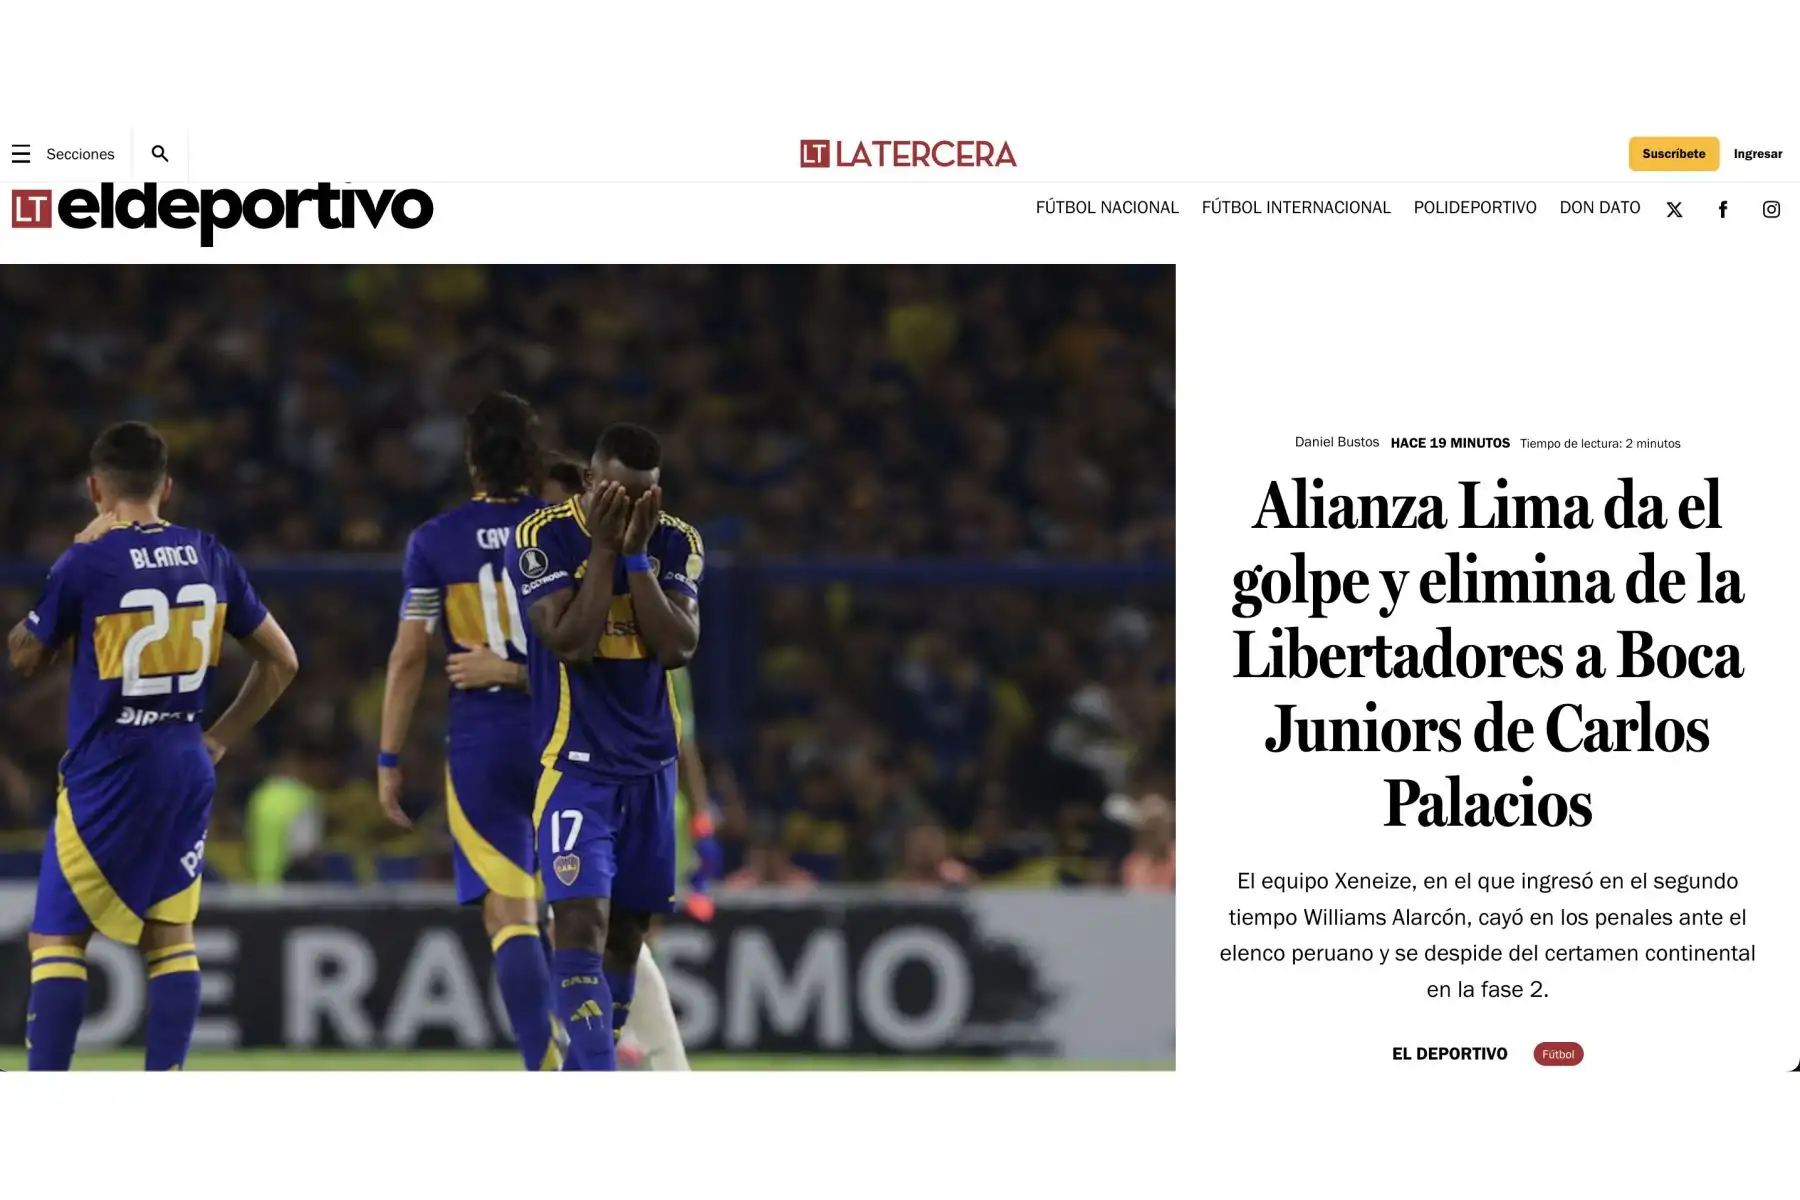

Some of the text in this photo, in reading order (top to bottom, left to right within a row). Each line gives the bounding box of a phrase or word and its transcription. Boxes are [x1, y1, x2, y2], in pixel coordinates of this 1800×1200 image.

[46, 147, 115, 161] Secciones
[803, 144, 827, 164] LT
[1642, 147, 1706, 159] Suscríbete
[1734, 148, 1783, 161] Ingresar
[16, 196, 48, 222] LT
[1036, 197, 1180, 214] FÚTBOL NACIONAL
[1202, 197, 1392, 214] FÚTBOL INTERNACIONAL
[1414, 200, 1537, 214] POLIDEPORTIVO
[1560, 200, 1641, 214] DON DATO
[1295, 436, 1380, 448] Daniel Bustos
[1391, 437, 1511, 449] HACE 19 MINUTOS
[1519, 438, 1681, 451] Tiempo de lectura: 2 minutos
[1250, 476, 1723, 530] Alianza Lima da el
[129, 545, 199, 569] BLANCO
[1231, 551, 1746, 619] golpe y elimina de la
[119, 584, 217, 697] 23
[1232, 626, 1745, 679] Libertadores a Boca
[1264, 700, 1710, 753] Juniors de Carlos
[1383, 774, 1593, 828] Palacios
[551, 809, 583, 854] 17
[1238, 871, 1739, 894] El equipo Xeneize, en el que ingresó en el segundo
[1228, 907, 1746, 930] tiempo Williams Alarcón, cayó en los penales ante el
[1220, 944, 1755, 966] elenco peruano y se despide del certamen continental
[1427, 980, 1549, 998] en la fase 2.
[1392, 1046, 1508, 1061] EL DEPORTIVO
[1542, 1047, 1575, 1060] Fútbol
